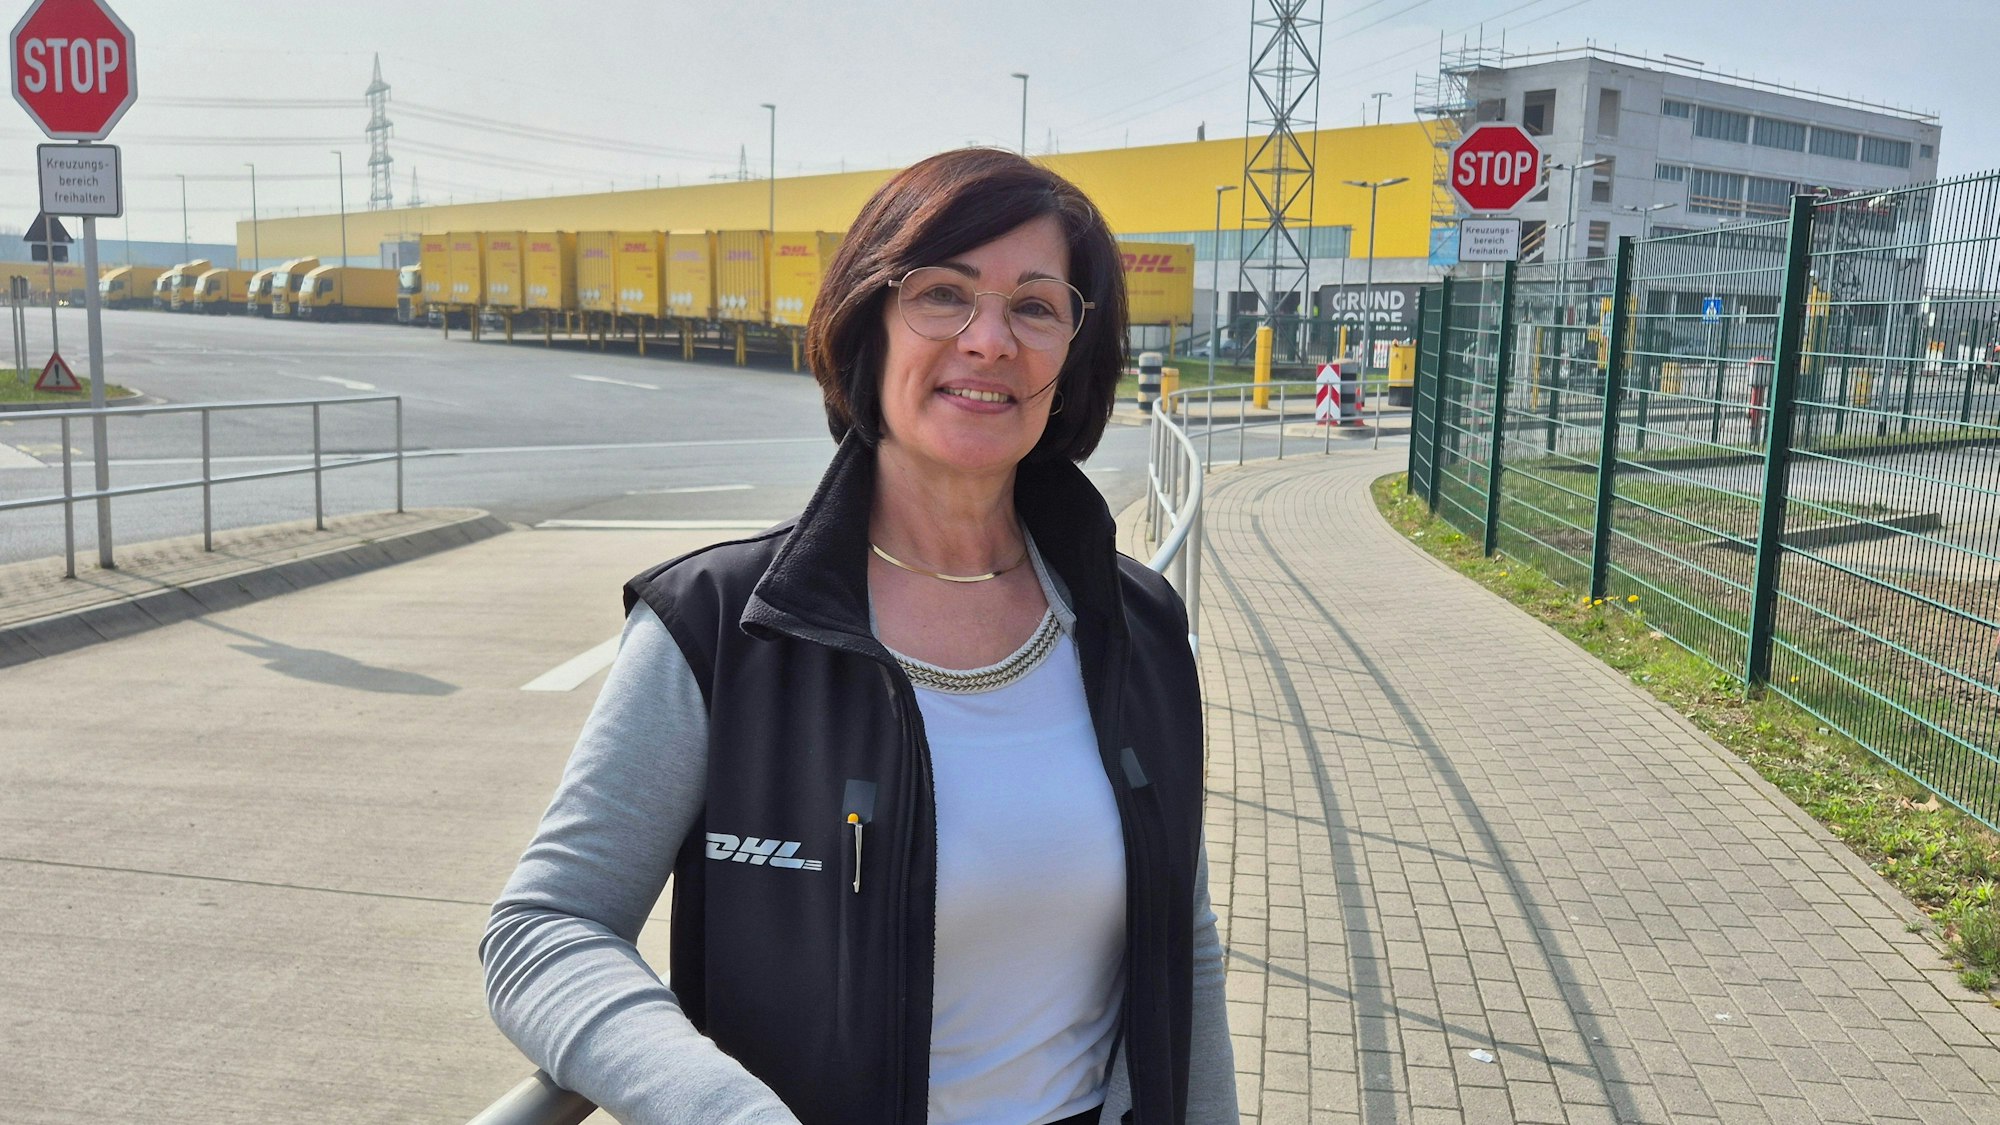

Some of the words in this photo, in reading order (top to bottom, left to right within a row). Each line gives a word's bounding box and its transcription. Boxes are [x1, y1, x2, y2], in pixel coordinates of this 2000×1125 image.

[24, 37, 120, 94] STOP
[46, 157, 109, 173] Kreuzungs-
[1457, 150, 1533, 187] STOP
[59, 175, 99, 187] bereich
[54, 191, 106, 204] freihalten
[1465, 226, 1514, 236] Kreuzungs-
[1474, 237, 1505, 245] bereich
[1469, 247, 1509, 255] freihalten
[1121, 253, 1186, 273] DHL
[1332, 290, 1405, 311] GRUND
[705, 831, 823, 872] DHL
